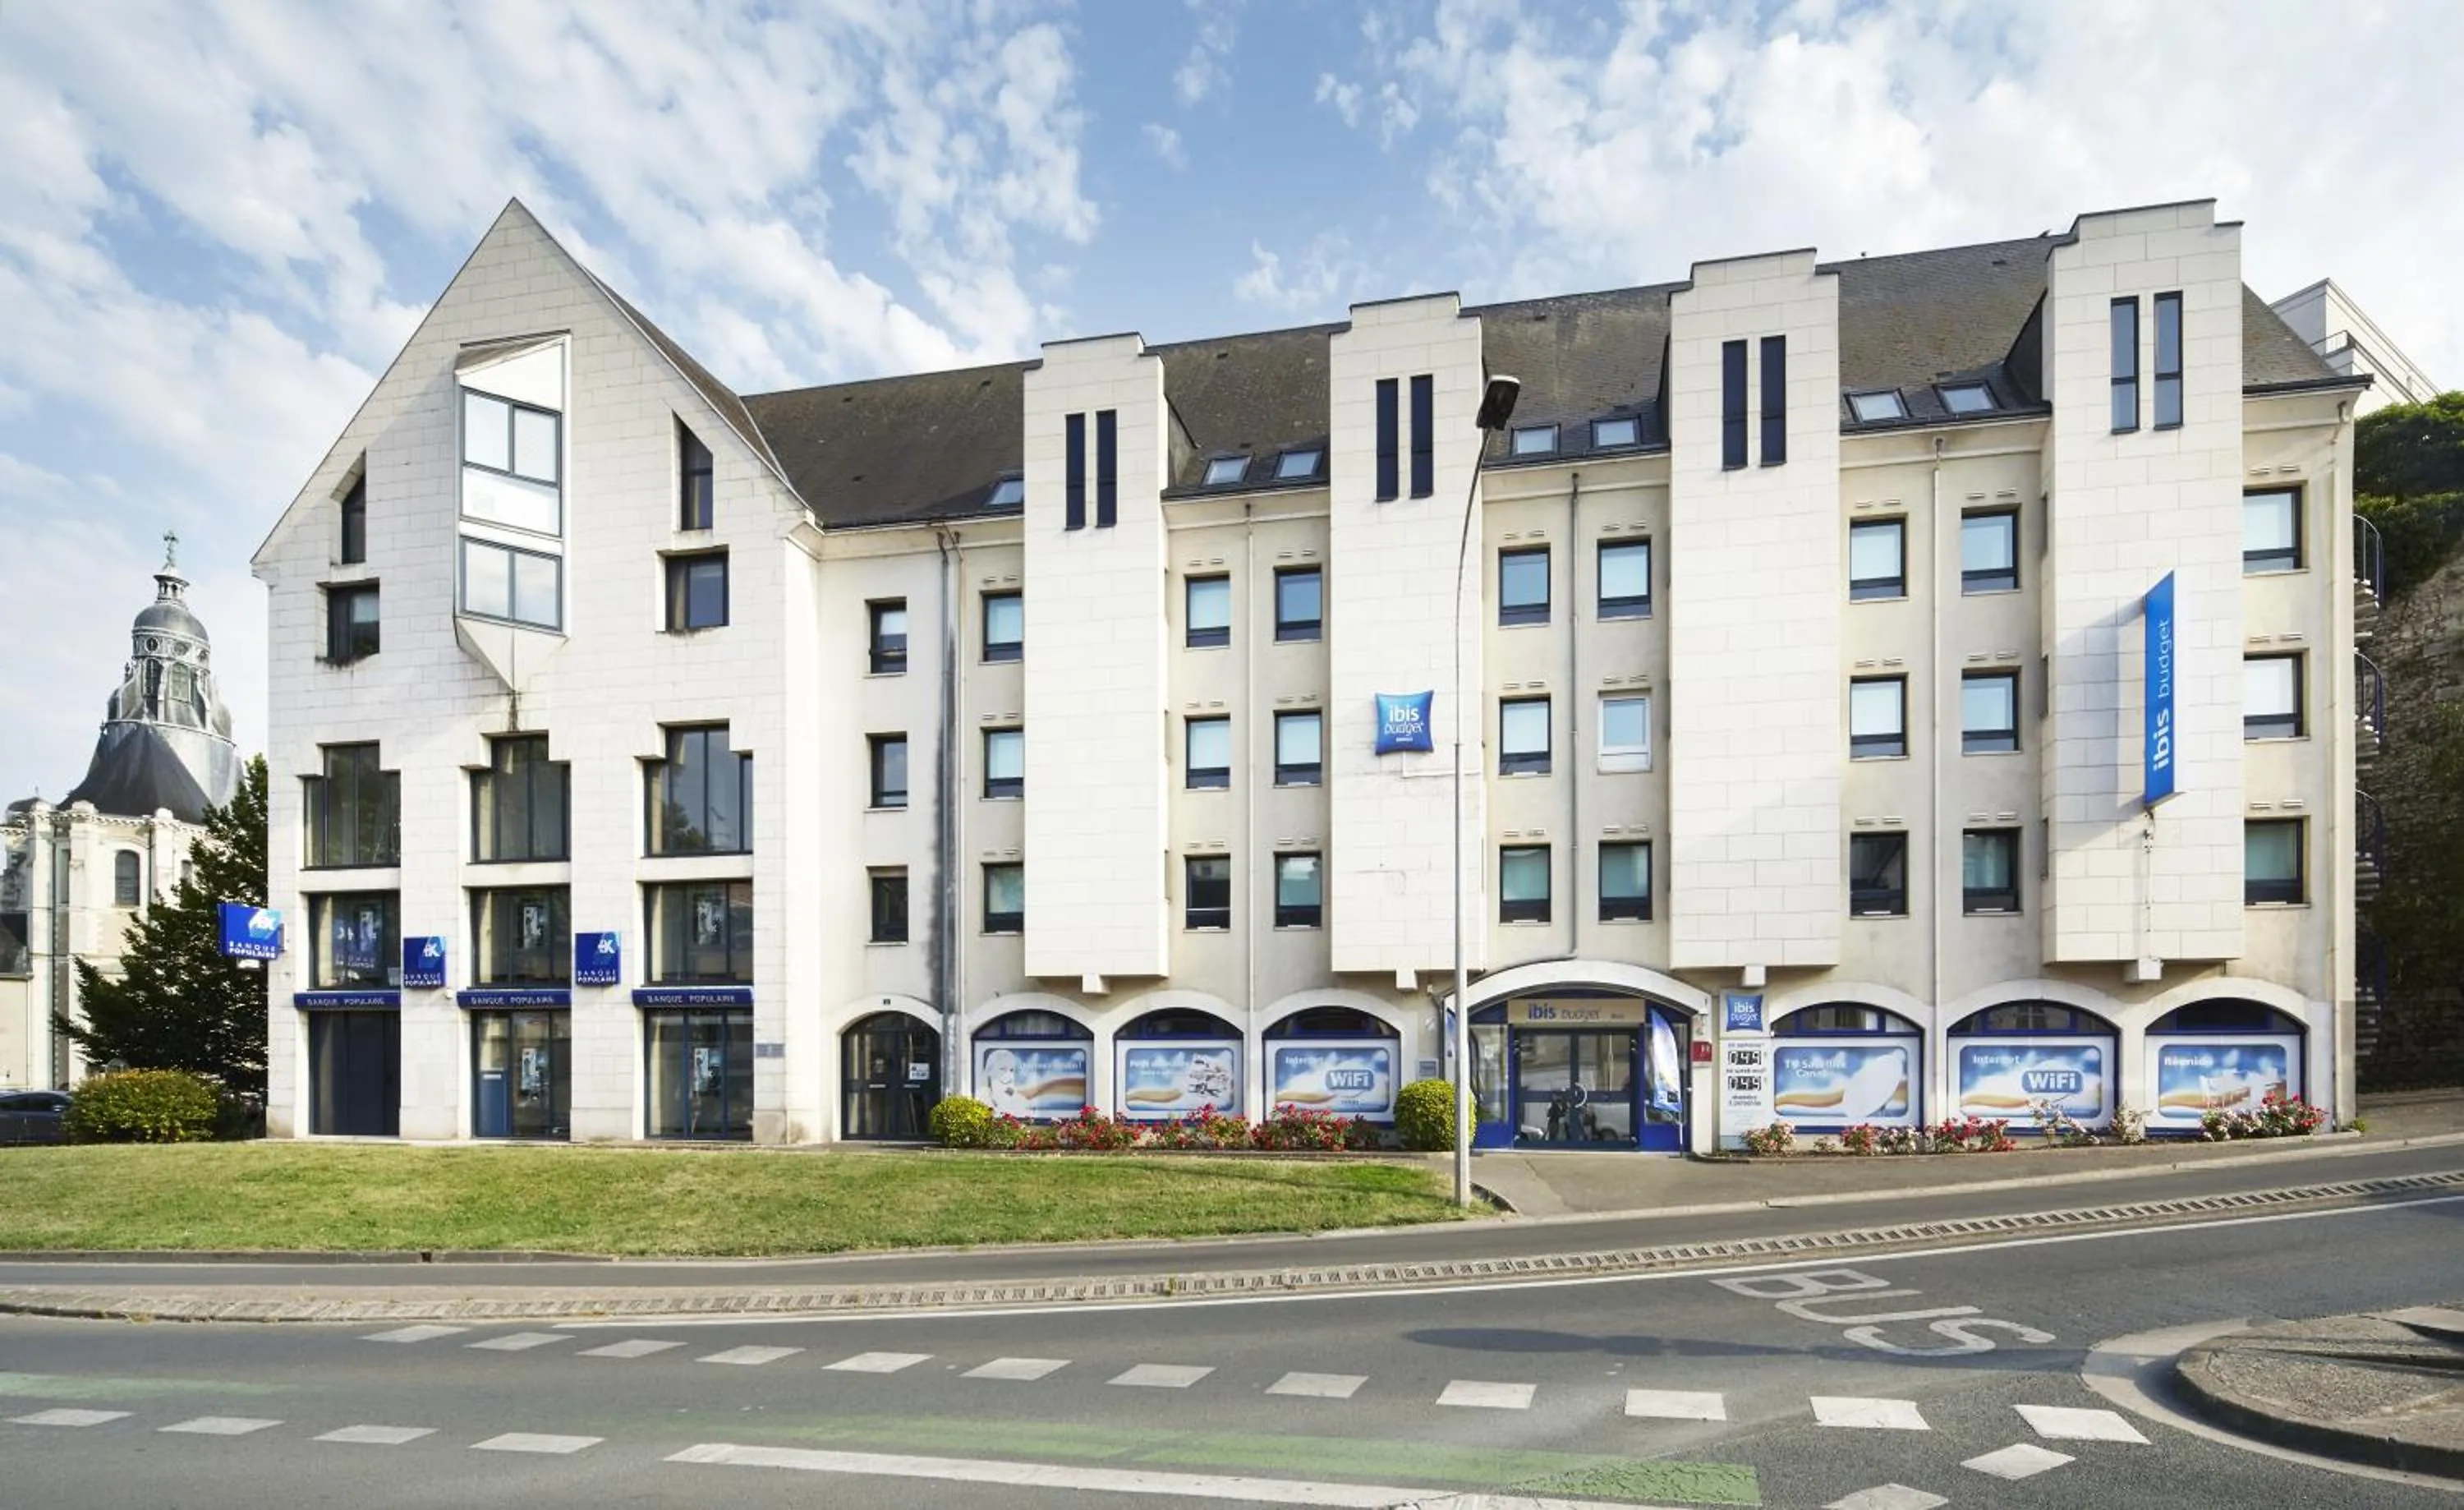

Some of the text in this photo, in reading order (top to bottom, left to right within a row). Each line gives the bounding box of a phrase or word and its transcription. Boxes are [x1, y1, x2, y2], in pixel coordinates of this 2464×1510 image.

[2153, 617, 2172, 771] ibis budget
[1389, 704, 1419, 722] ibis
[1384, 721, 1424, 736] budget
[229, 941, 275, 952] BANQUE
[229, 947, 276, 959] POPULAIRE
[471, 997, 554, 1005] BANQUE POPULAIRE
[646, 995, 735, 1003] BANQUE POPULAIRE
[1528, 1003, 1556, 1020] ibis
[1561, 1006, 1601, 1020] budget
[1734, 1001, 1755, 1013] ibis
[1973, 1055, 2020, 1064] Internet
[1331, 1071, 1369, 1088] WiFi
[2028, 1072, 2076, 1089] WiFi
[1709, 1268, 2056, 1356] BUS
